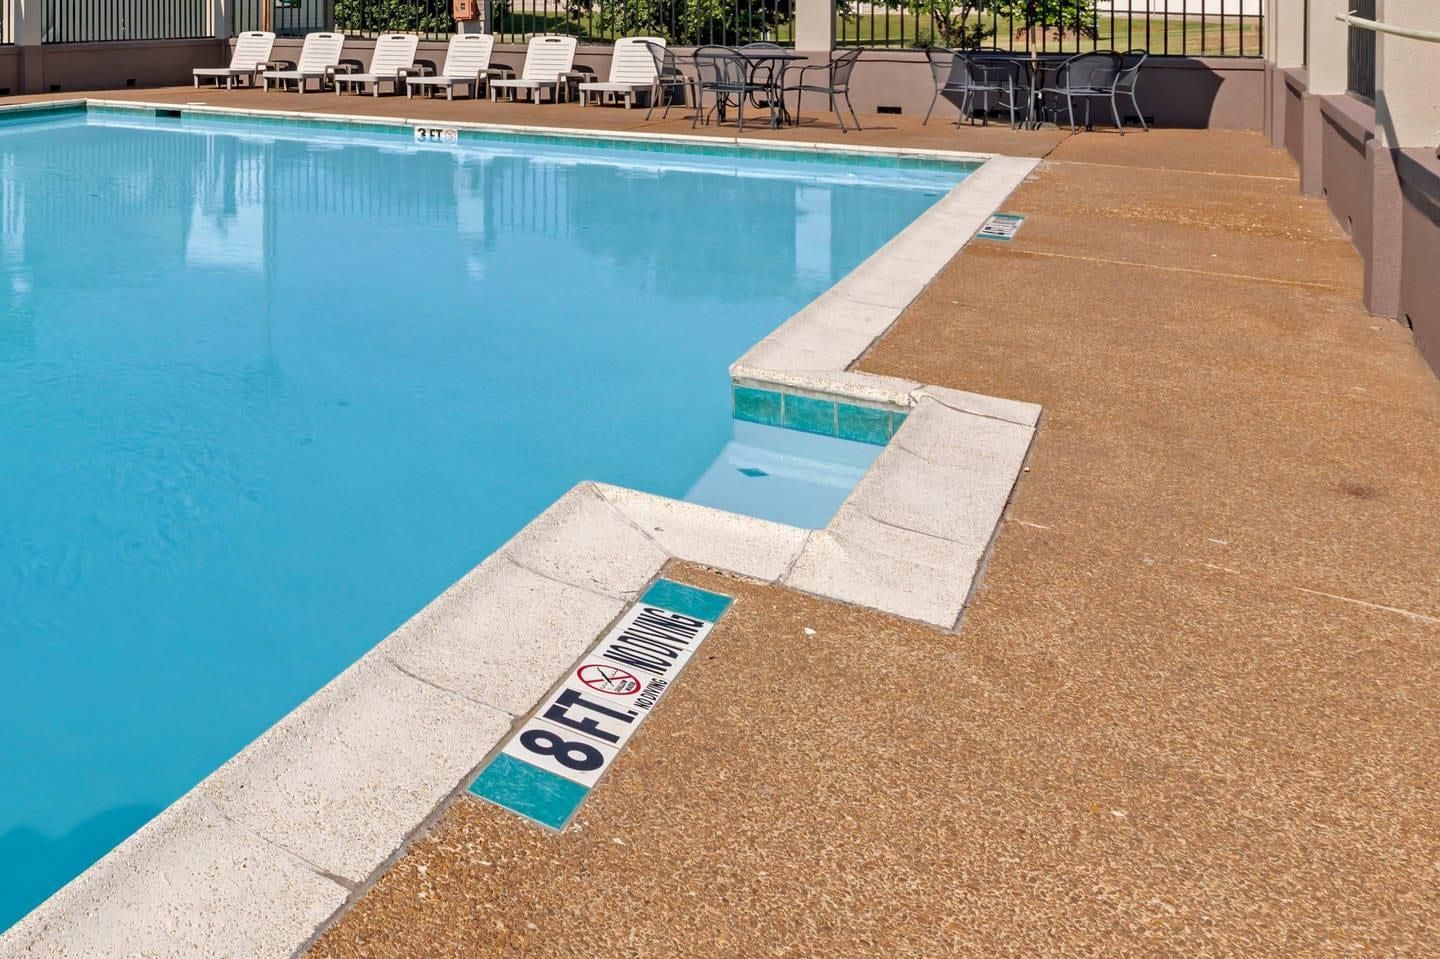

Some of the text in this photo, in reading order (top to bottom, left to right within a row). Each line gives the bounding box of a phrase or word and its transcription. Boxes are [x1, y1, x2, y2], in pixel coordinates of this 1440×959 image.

[417, 128, 427, 138] 3
[519, 607, 705, 771] 8 FT. NO DIVING
[633, 677, 668, 711] NO DIVING
